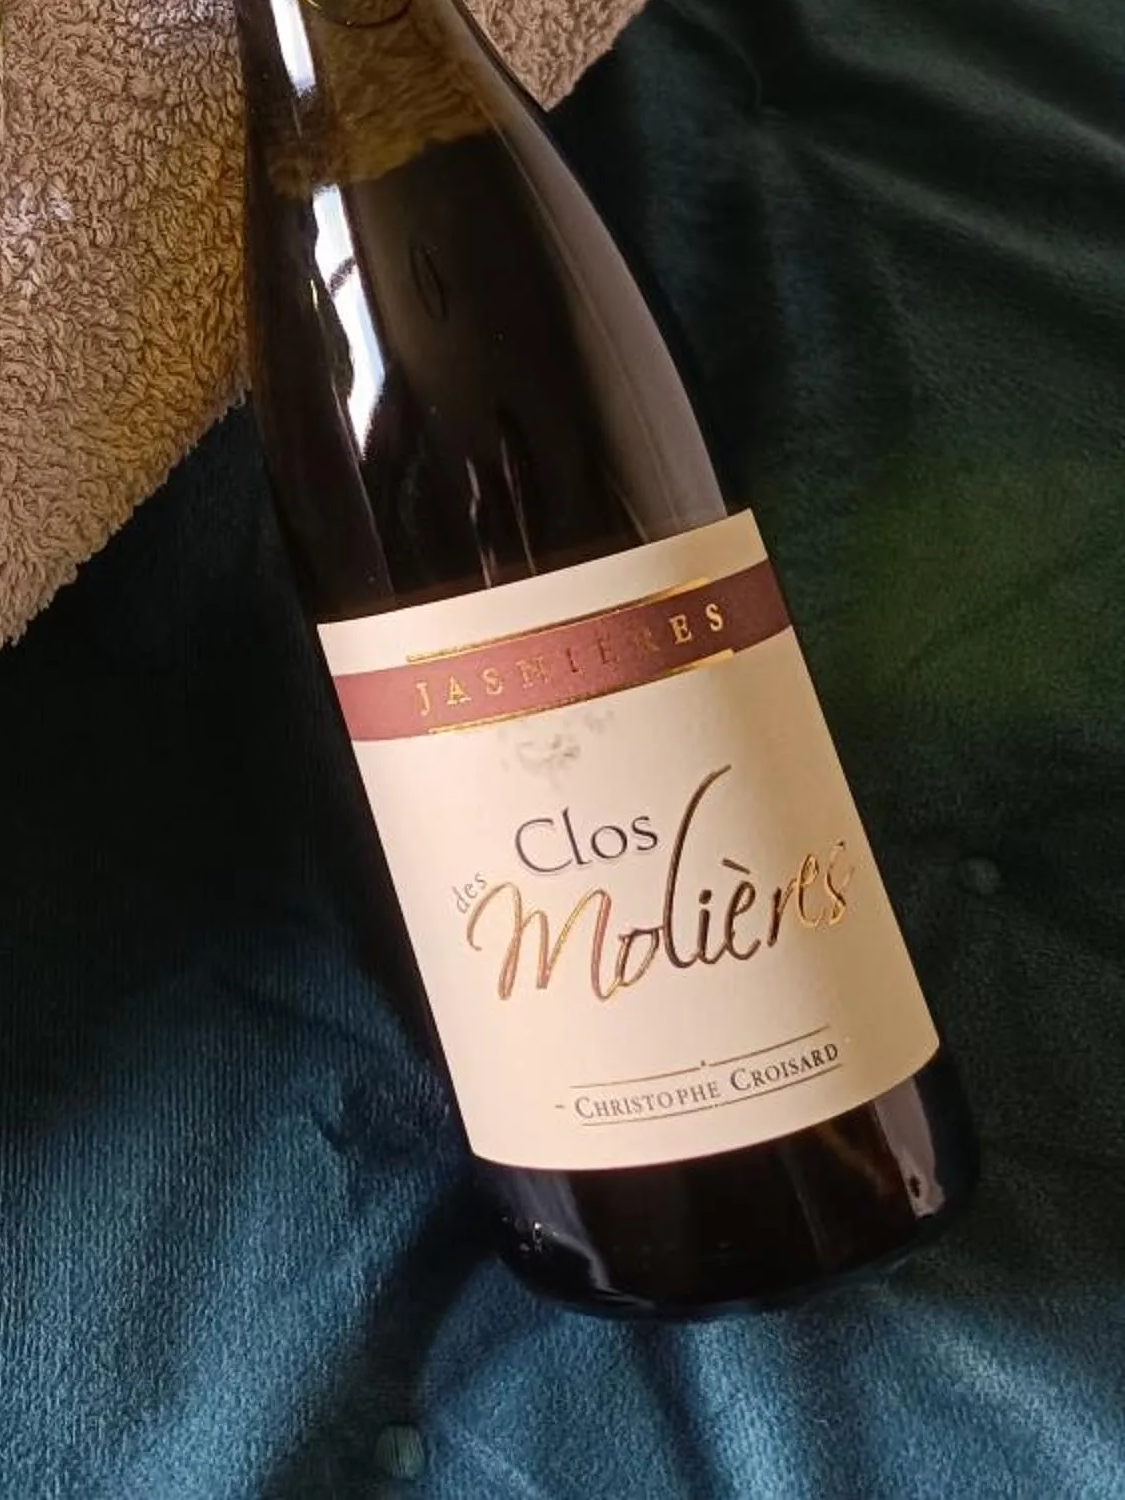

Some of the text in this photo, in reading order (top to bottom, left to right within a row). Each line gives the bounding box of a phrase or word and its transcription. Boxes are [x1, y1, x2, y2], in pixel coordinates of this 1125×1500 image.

[514, 806, 659, 874] Clos
[454, 869, 488, 914] des
[466, 764, 852, 1001] Molières
[574, 1043, 839, 1121] CHRISTOPHE CROISARD
